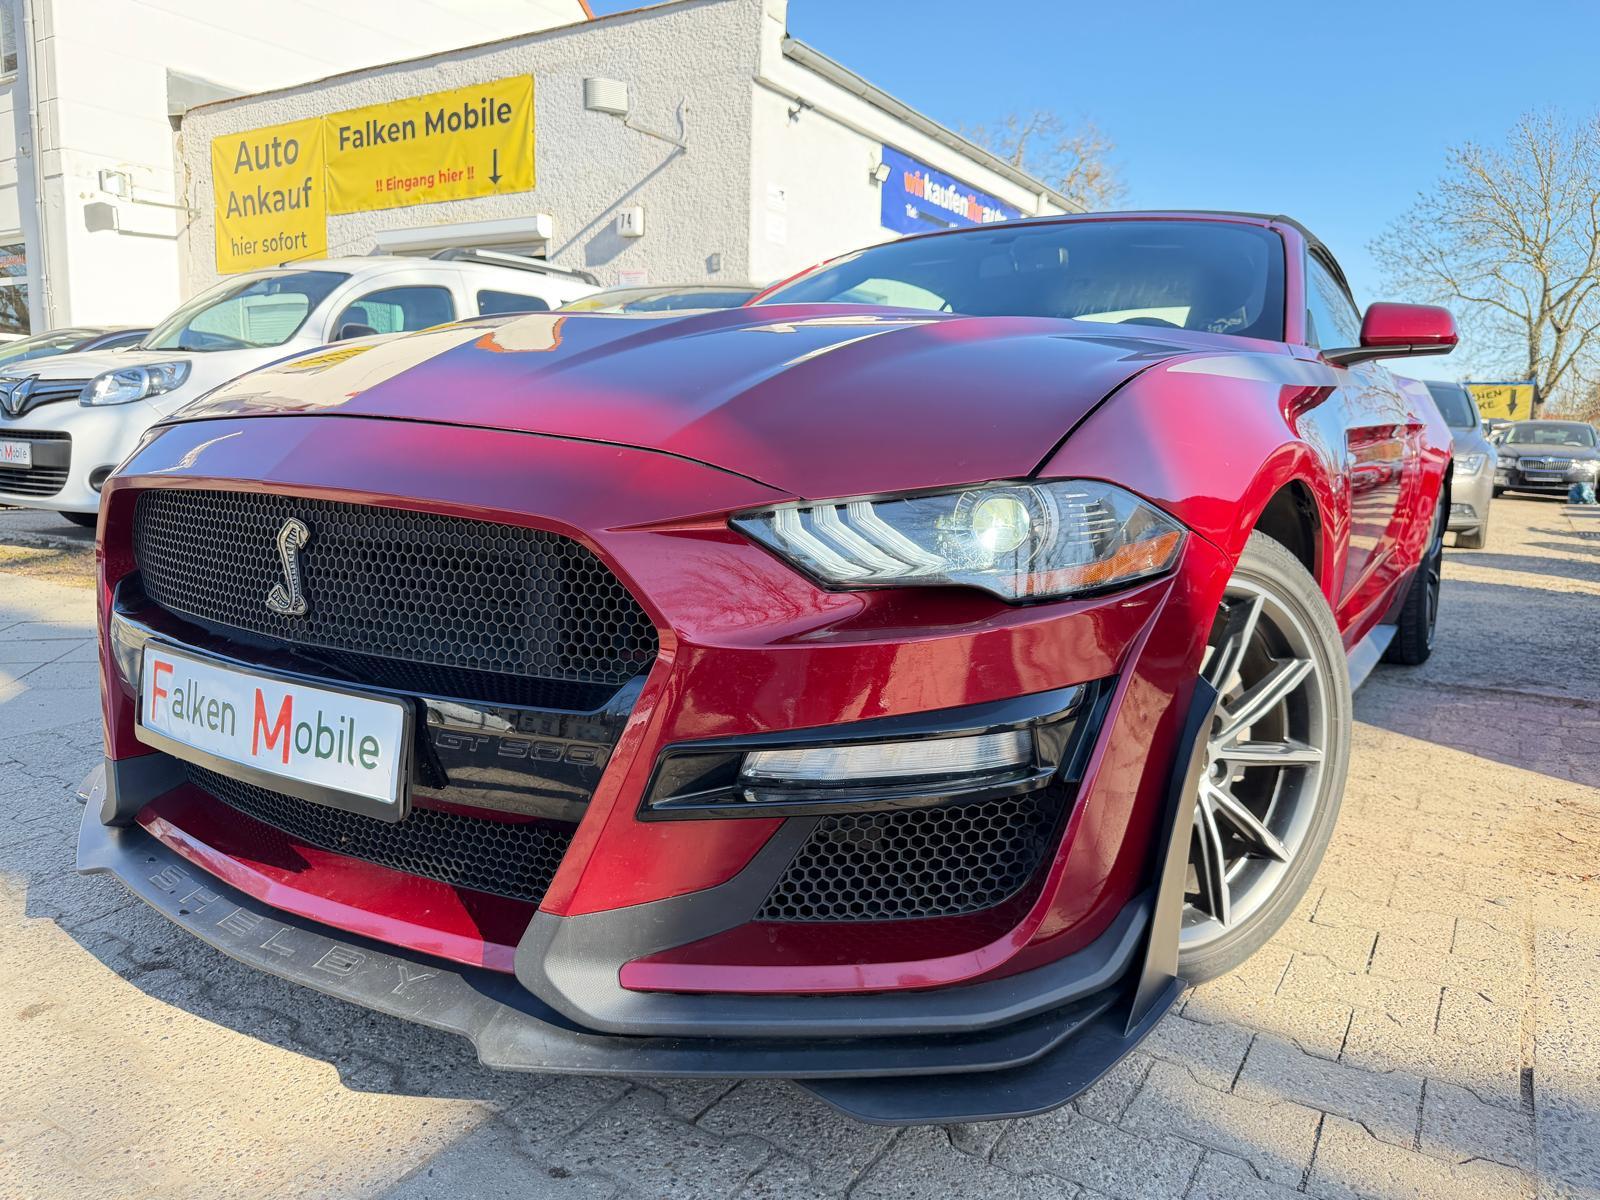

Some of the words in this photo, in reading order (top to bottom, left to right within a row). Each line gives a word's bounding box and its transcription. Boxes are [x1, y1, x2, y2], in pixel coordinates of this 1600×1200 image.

[338, 118, 417, 152] Falken
[424, 97, 513, 137] Mobile
[233, 137, 300, 174] Auto
[226, 177, 313, 219] Ankauf
[386, 172, 435, 193] Eingang
[438, 168, 464, 185] hier
[621, 213, 632, 228] 74
[231, 236, 258, 257] hier
[262, 231, 308, 254] sofort
[151, 659, 237, 737] Falken
[251, 687, 381, 771] Mobile
[435, 730, 490, 752] GT
[149, 864, 436, 996] SHELBY
